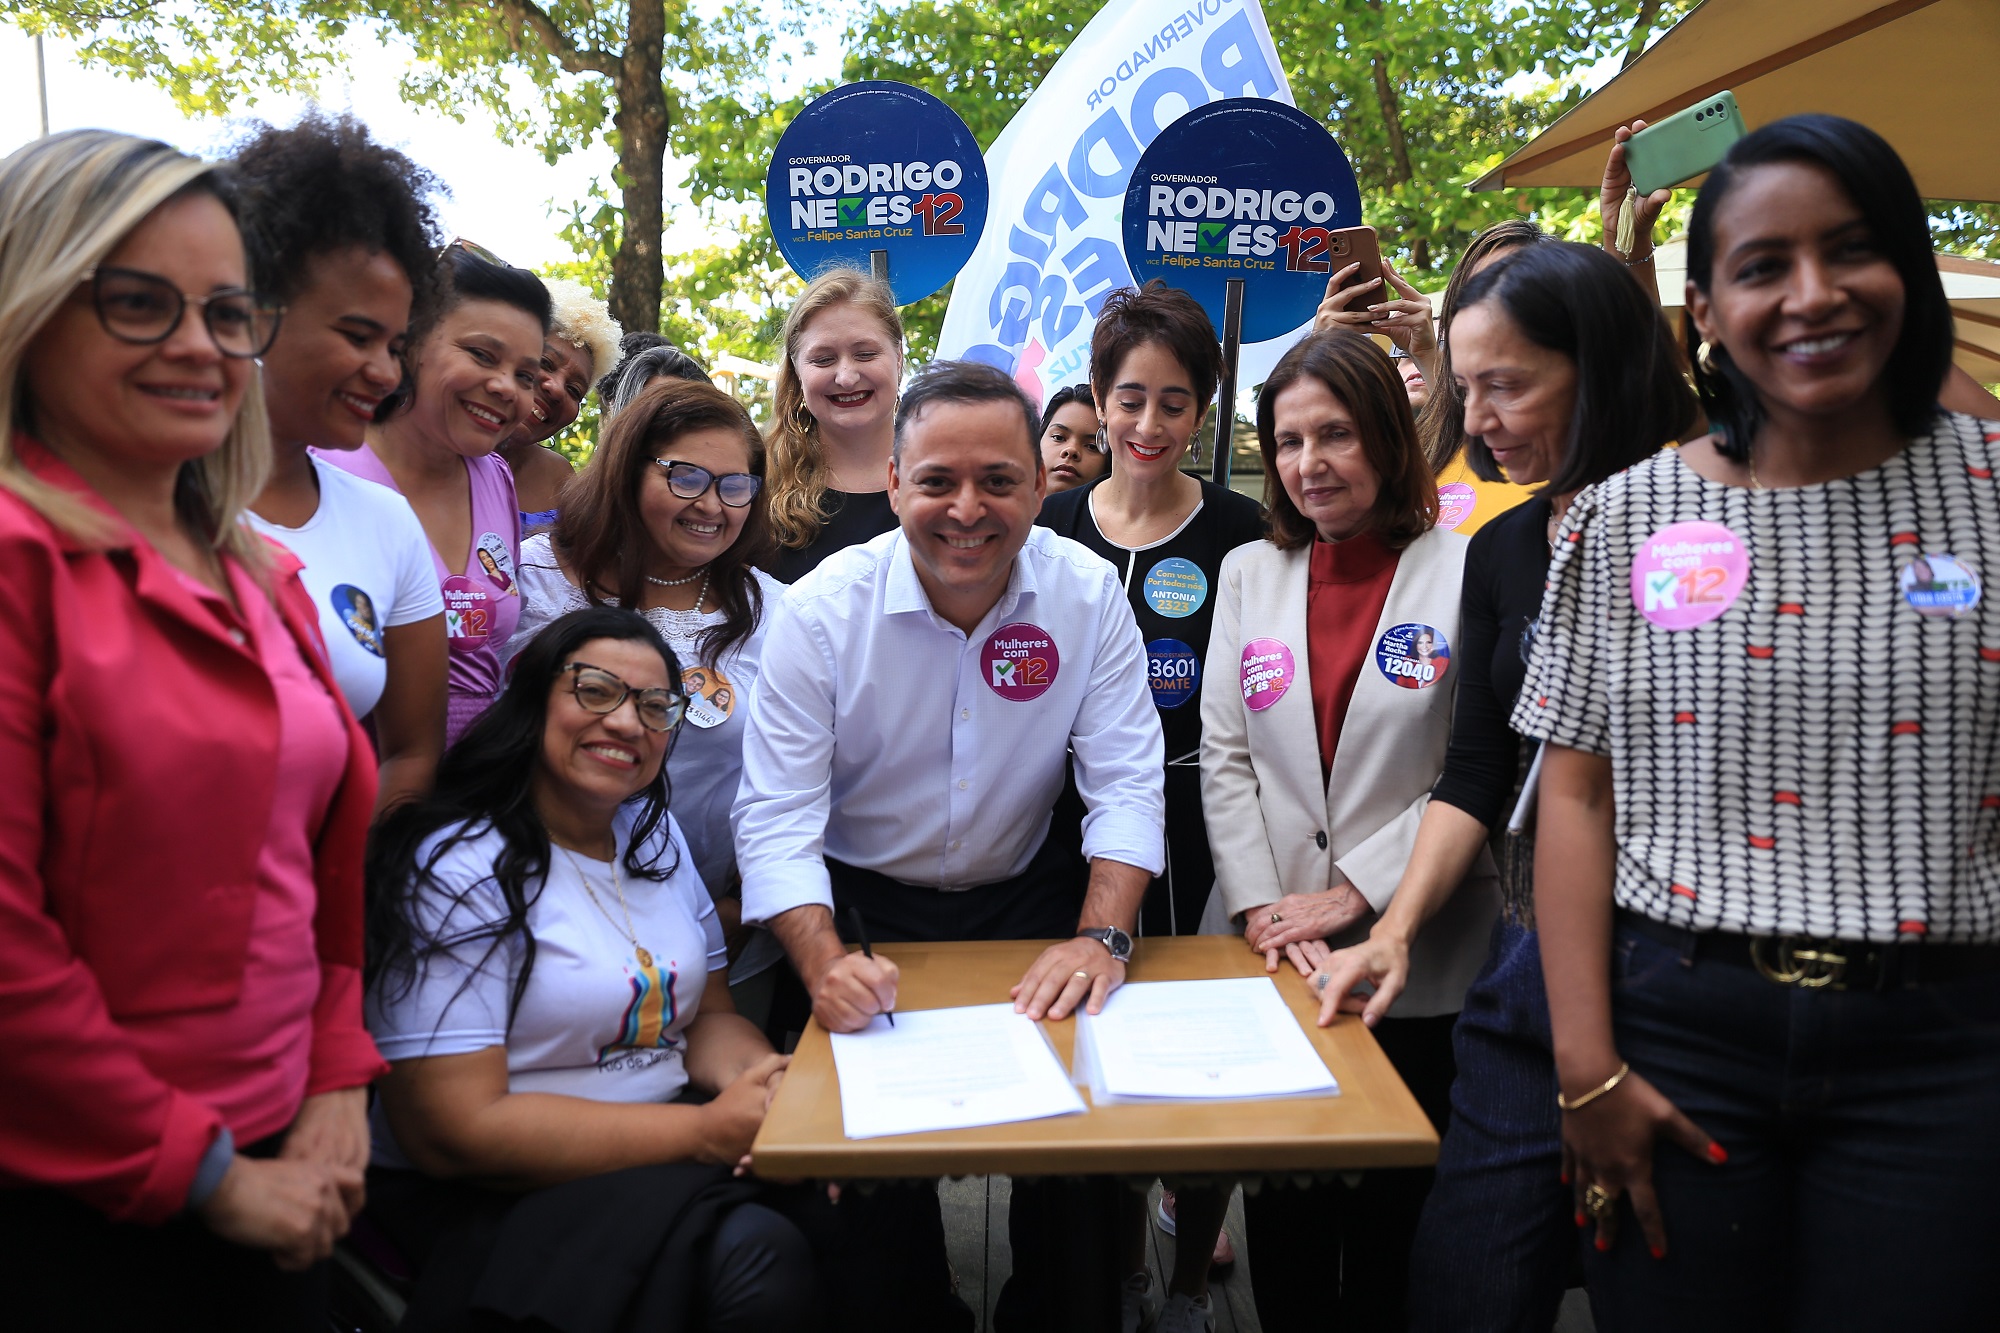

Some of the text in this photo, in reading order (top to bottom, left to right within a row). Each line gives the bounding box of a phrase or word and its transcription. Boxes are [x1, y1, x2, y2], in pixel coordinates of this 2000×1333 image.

[789, 155, 850, 165] GOVERNADOR
[789, 160, 963, 197] RODRIGO
[1150, 174, 1218, 184] GOVERNADOR
[1148, 184, 1335, 224] RODRIGO
[913, 192, 965, 237] 12
[807, 231, 843, 244] Felipe
[846, 229, 881, 241] Santa
[883, 227, 913, 238] Cruz
[1278, 225, 1331, 274] 12
[1162, 254, 1200, 269] Felipe
[1203, 256, 1241, 269] Santa
[1243, 257, 1275, 270] Cruz
[1651, 541, 1734, 558] Mulheres
[1662, 555, 1702, 569] com
[1156, 570, 1175, 578] Com
[1147, 577, 1162, 585] Por
[1163, 579, 1186, 588] todas
[444, 590, 487, 600] Mulheres
[1152, 590, 1196, 602] ANTONIA
[1157, 600, 1189, 612] 2323
[994, 638, 1048, 650] Mulheres
[1383, 639, 1408, 650] Martha
[1385, 645, 1407, 656] Rocha
[1003, 649, 1029, 658] com
[1148, 658, 1195, 678] 3601
[1243, 652, 1282, 670] Mulheres
[1246, 665, 1263, 675] com
[1384, 657, 1435, 681] 12040
[1243, 667, 1284, 690] RODRIGO
[1268, 677, 1284, 692] 12
